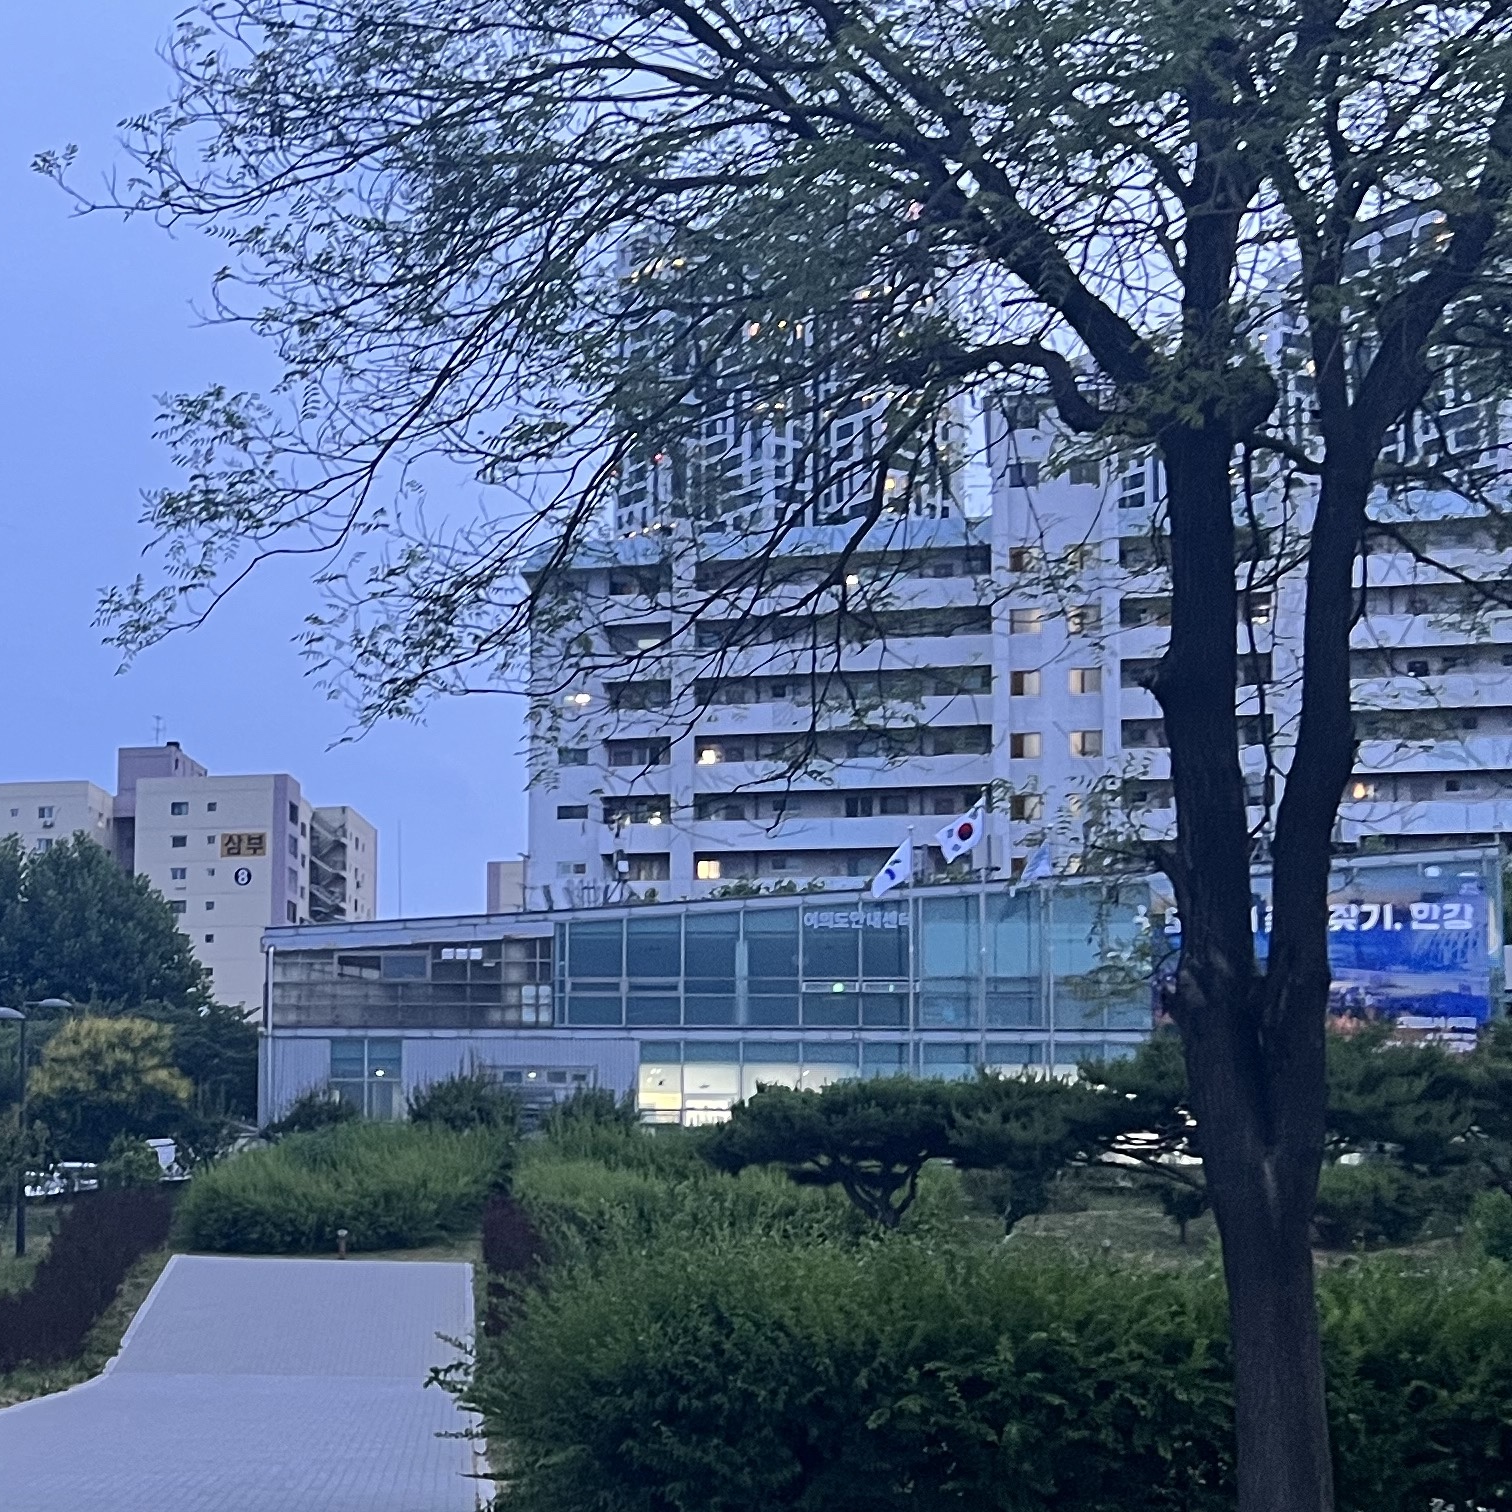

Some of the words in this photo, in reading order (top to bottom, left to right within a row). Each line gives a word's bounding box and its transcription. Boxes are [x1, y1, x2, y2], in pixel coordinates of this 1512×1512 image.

[224, 833, 265, 856] 삼부
[237, 868, 250, 885] 8
[1409, 901, 1475, 931] 한강
